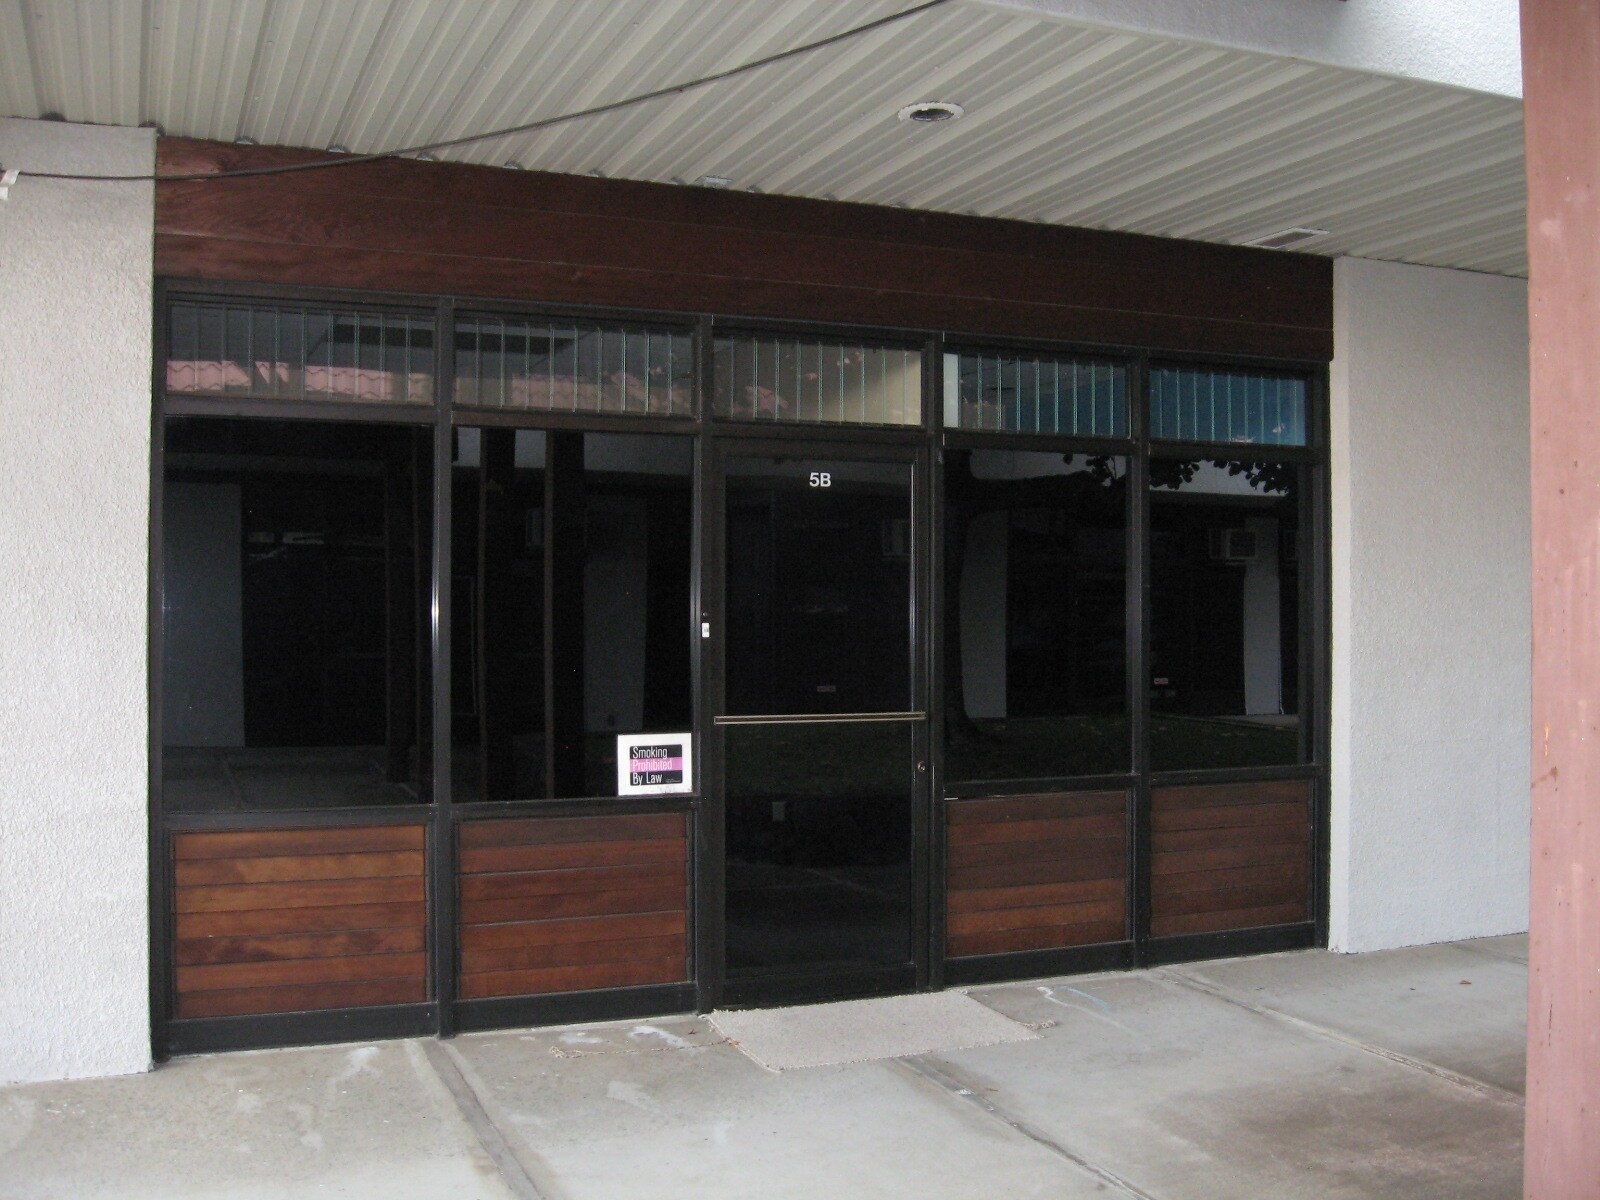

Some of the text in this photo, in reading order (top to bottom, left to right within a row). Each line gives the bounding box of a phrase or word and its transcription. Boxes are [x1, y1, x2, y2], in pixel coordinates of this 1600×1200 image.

[809, 472, 832, 487] 5B
[633, 746, 668, 760] Smoking
[633, 759, 672, 771] Prohibited
[633, 772, 643, 785] By
[646, 771, 662, 784] Law
